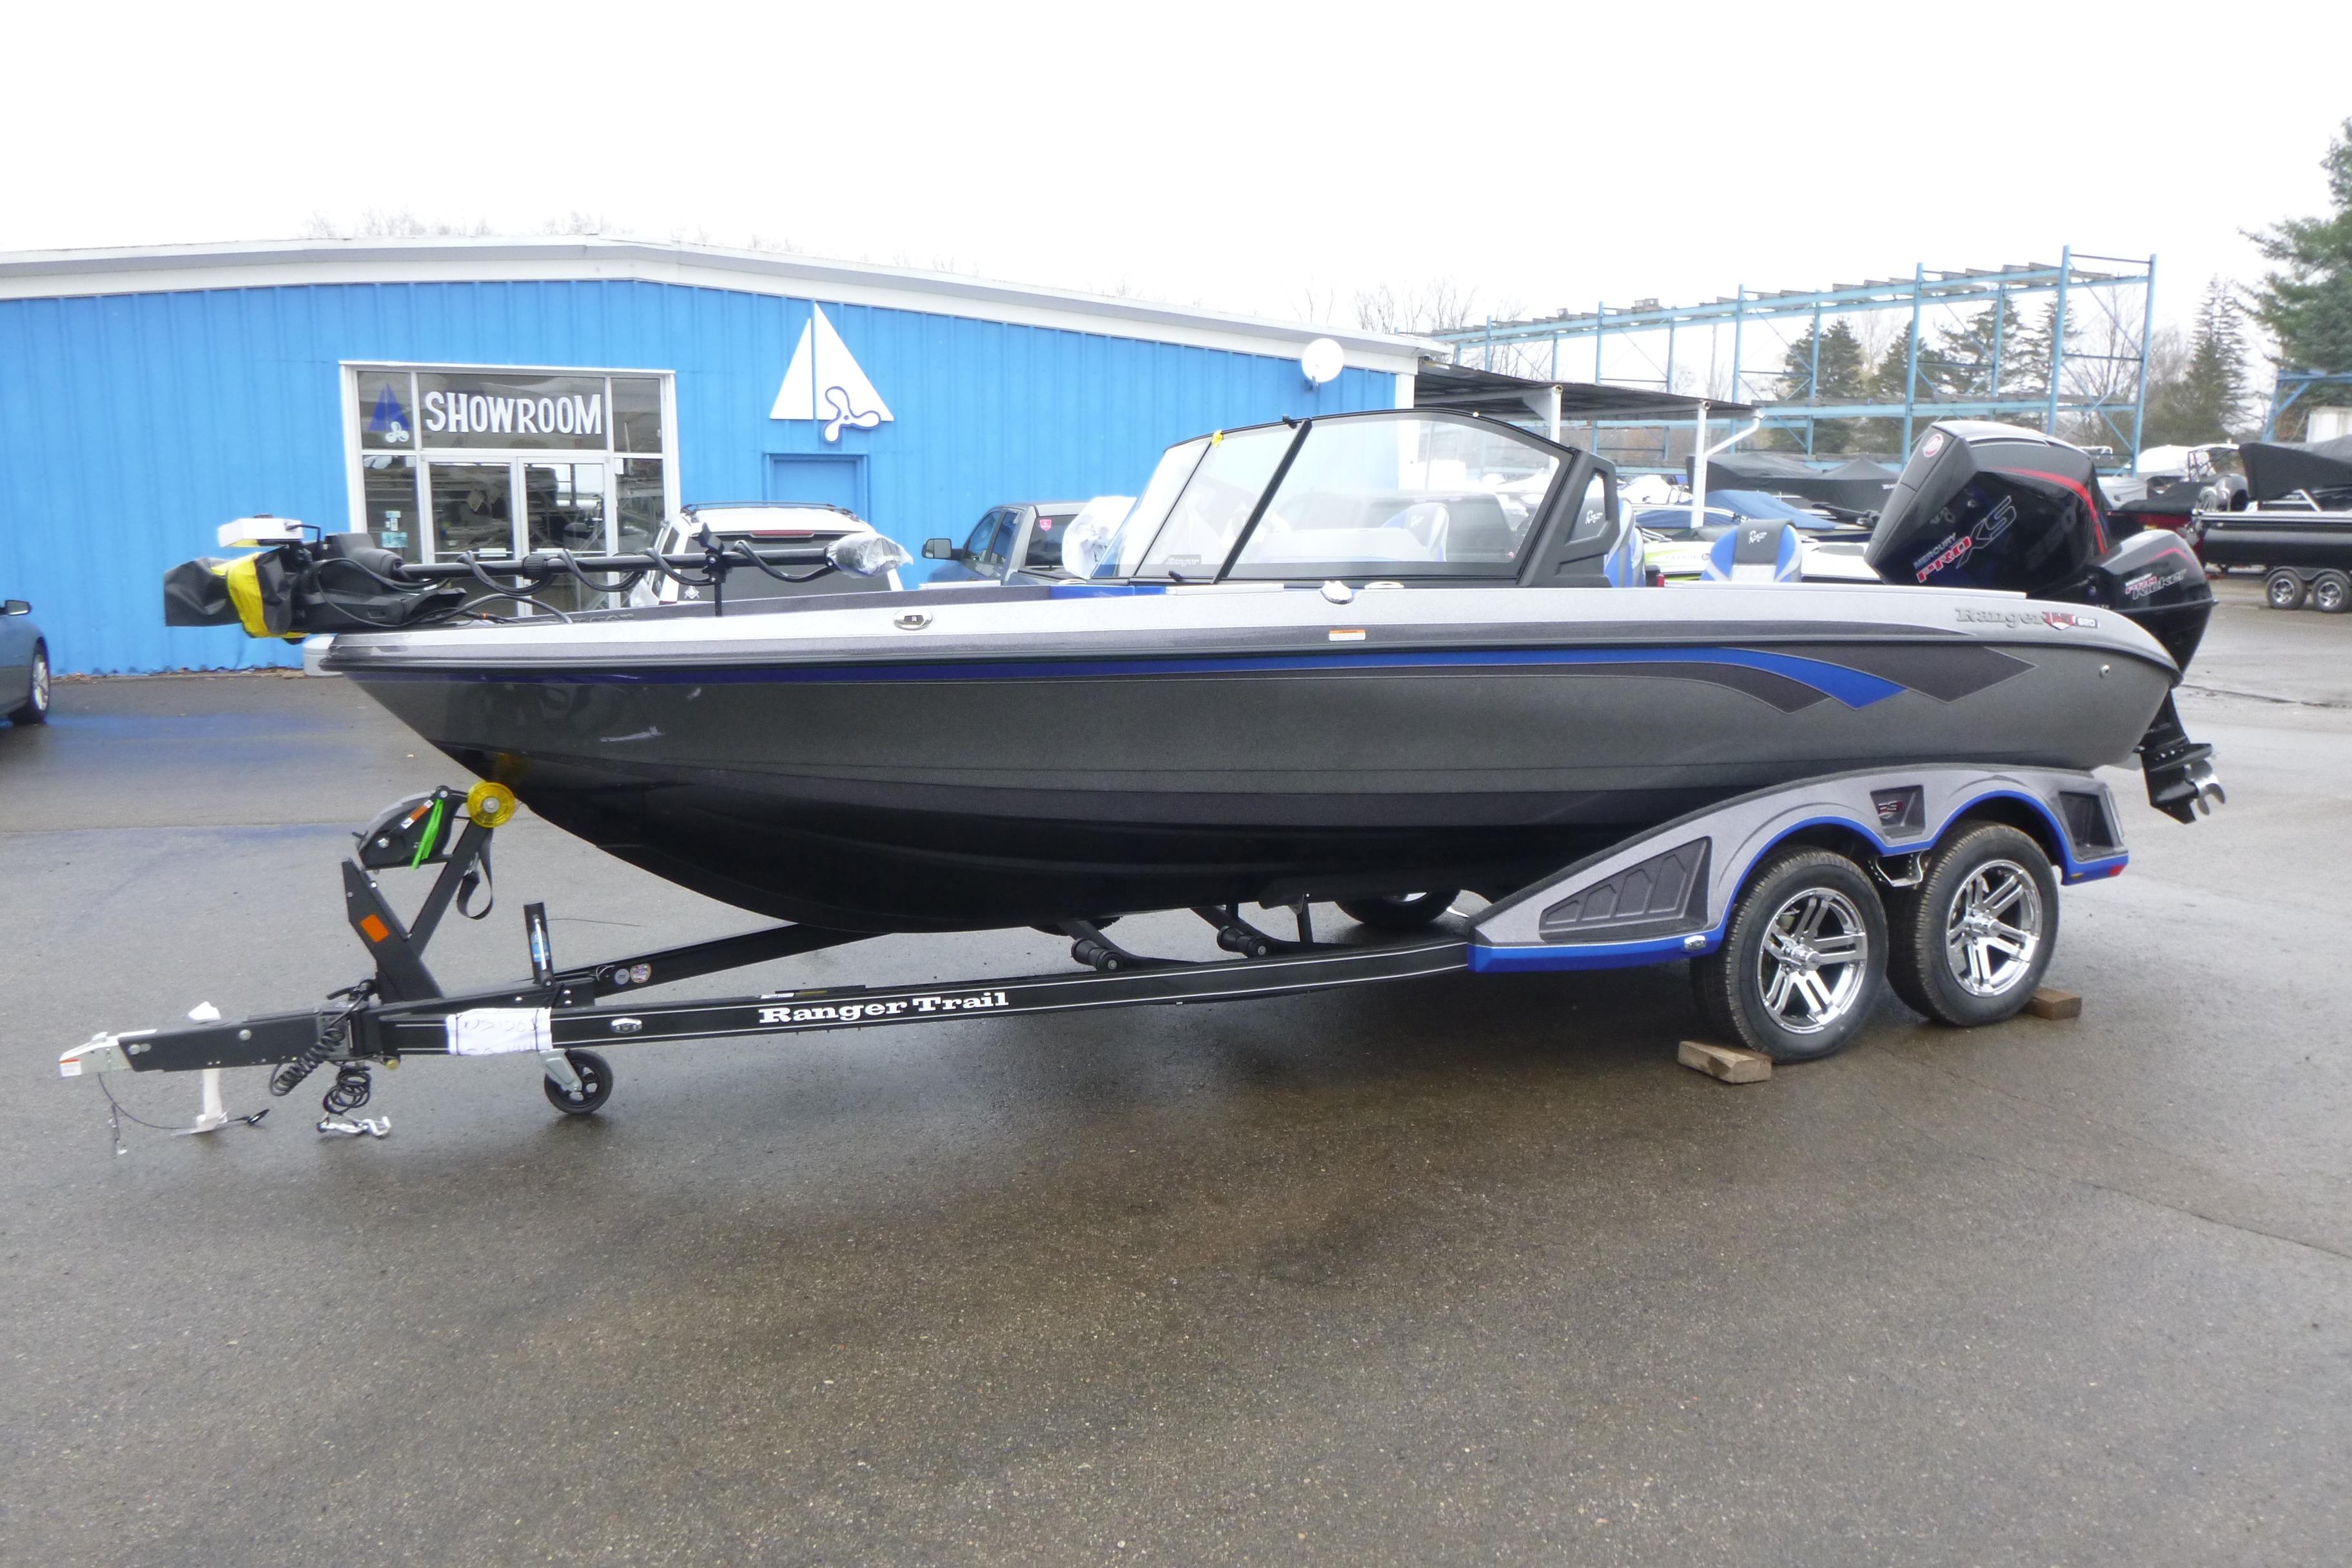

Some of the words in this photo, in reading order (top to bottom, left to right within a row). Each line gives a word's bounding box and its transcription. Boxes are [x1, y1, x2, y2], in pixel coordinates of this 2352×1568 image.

[425, 391, 602, 435] SHOWROOM
[1913, 532, 1957, 569] MERCURY
[1916, 536, 1972, 583] PRO
[1955, 495, 2017, 570] XS
[1955, 608, 2045, 629] Ranger
[758, 1001, 908, 1024] Ranger
[912, 992, 1009, 1012] Trail
